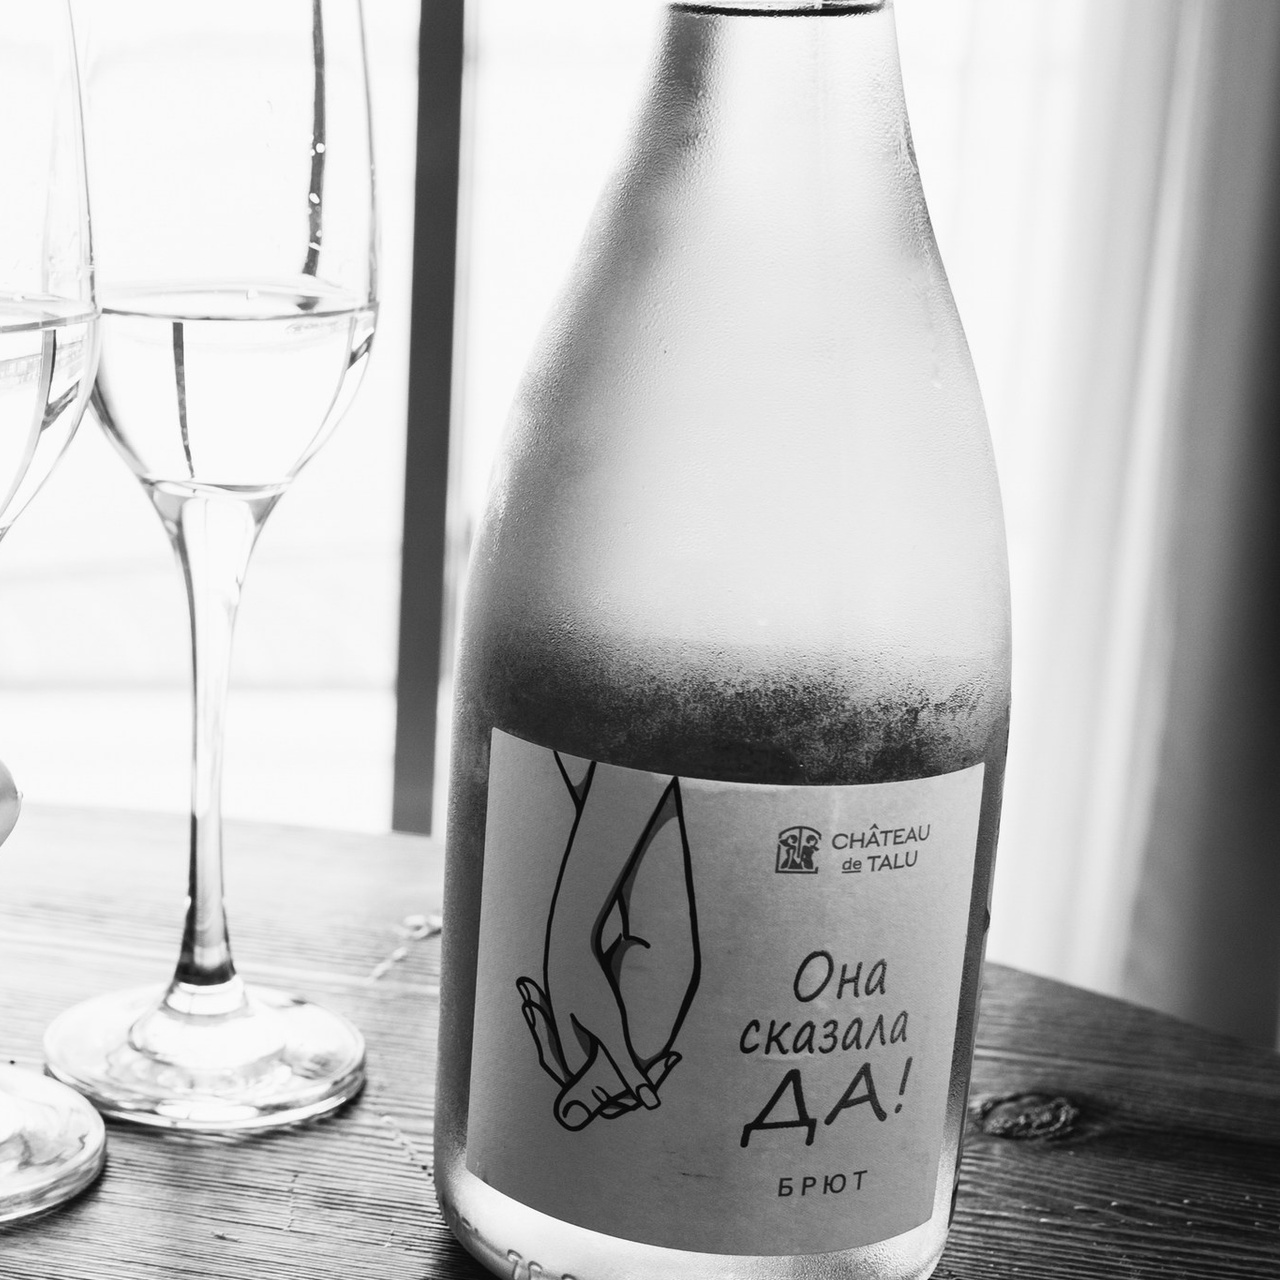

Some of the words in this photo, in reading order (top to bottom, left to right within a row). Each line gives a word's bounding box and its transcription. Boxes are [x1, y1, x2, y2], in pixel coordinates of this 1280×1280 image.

[831, 823, 931, 850] CHÂTEAU
[841, 857, 862, 873] de
[867, 850, 919, 872] TALU
[793, 950, 887, 1003] Она
[739, 1010, 909, 1055] сказала
[739, 1056, 913, 1148] ДА!
[777, 1170, 868, 1197] БРЮТ
